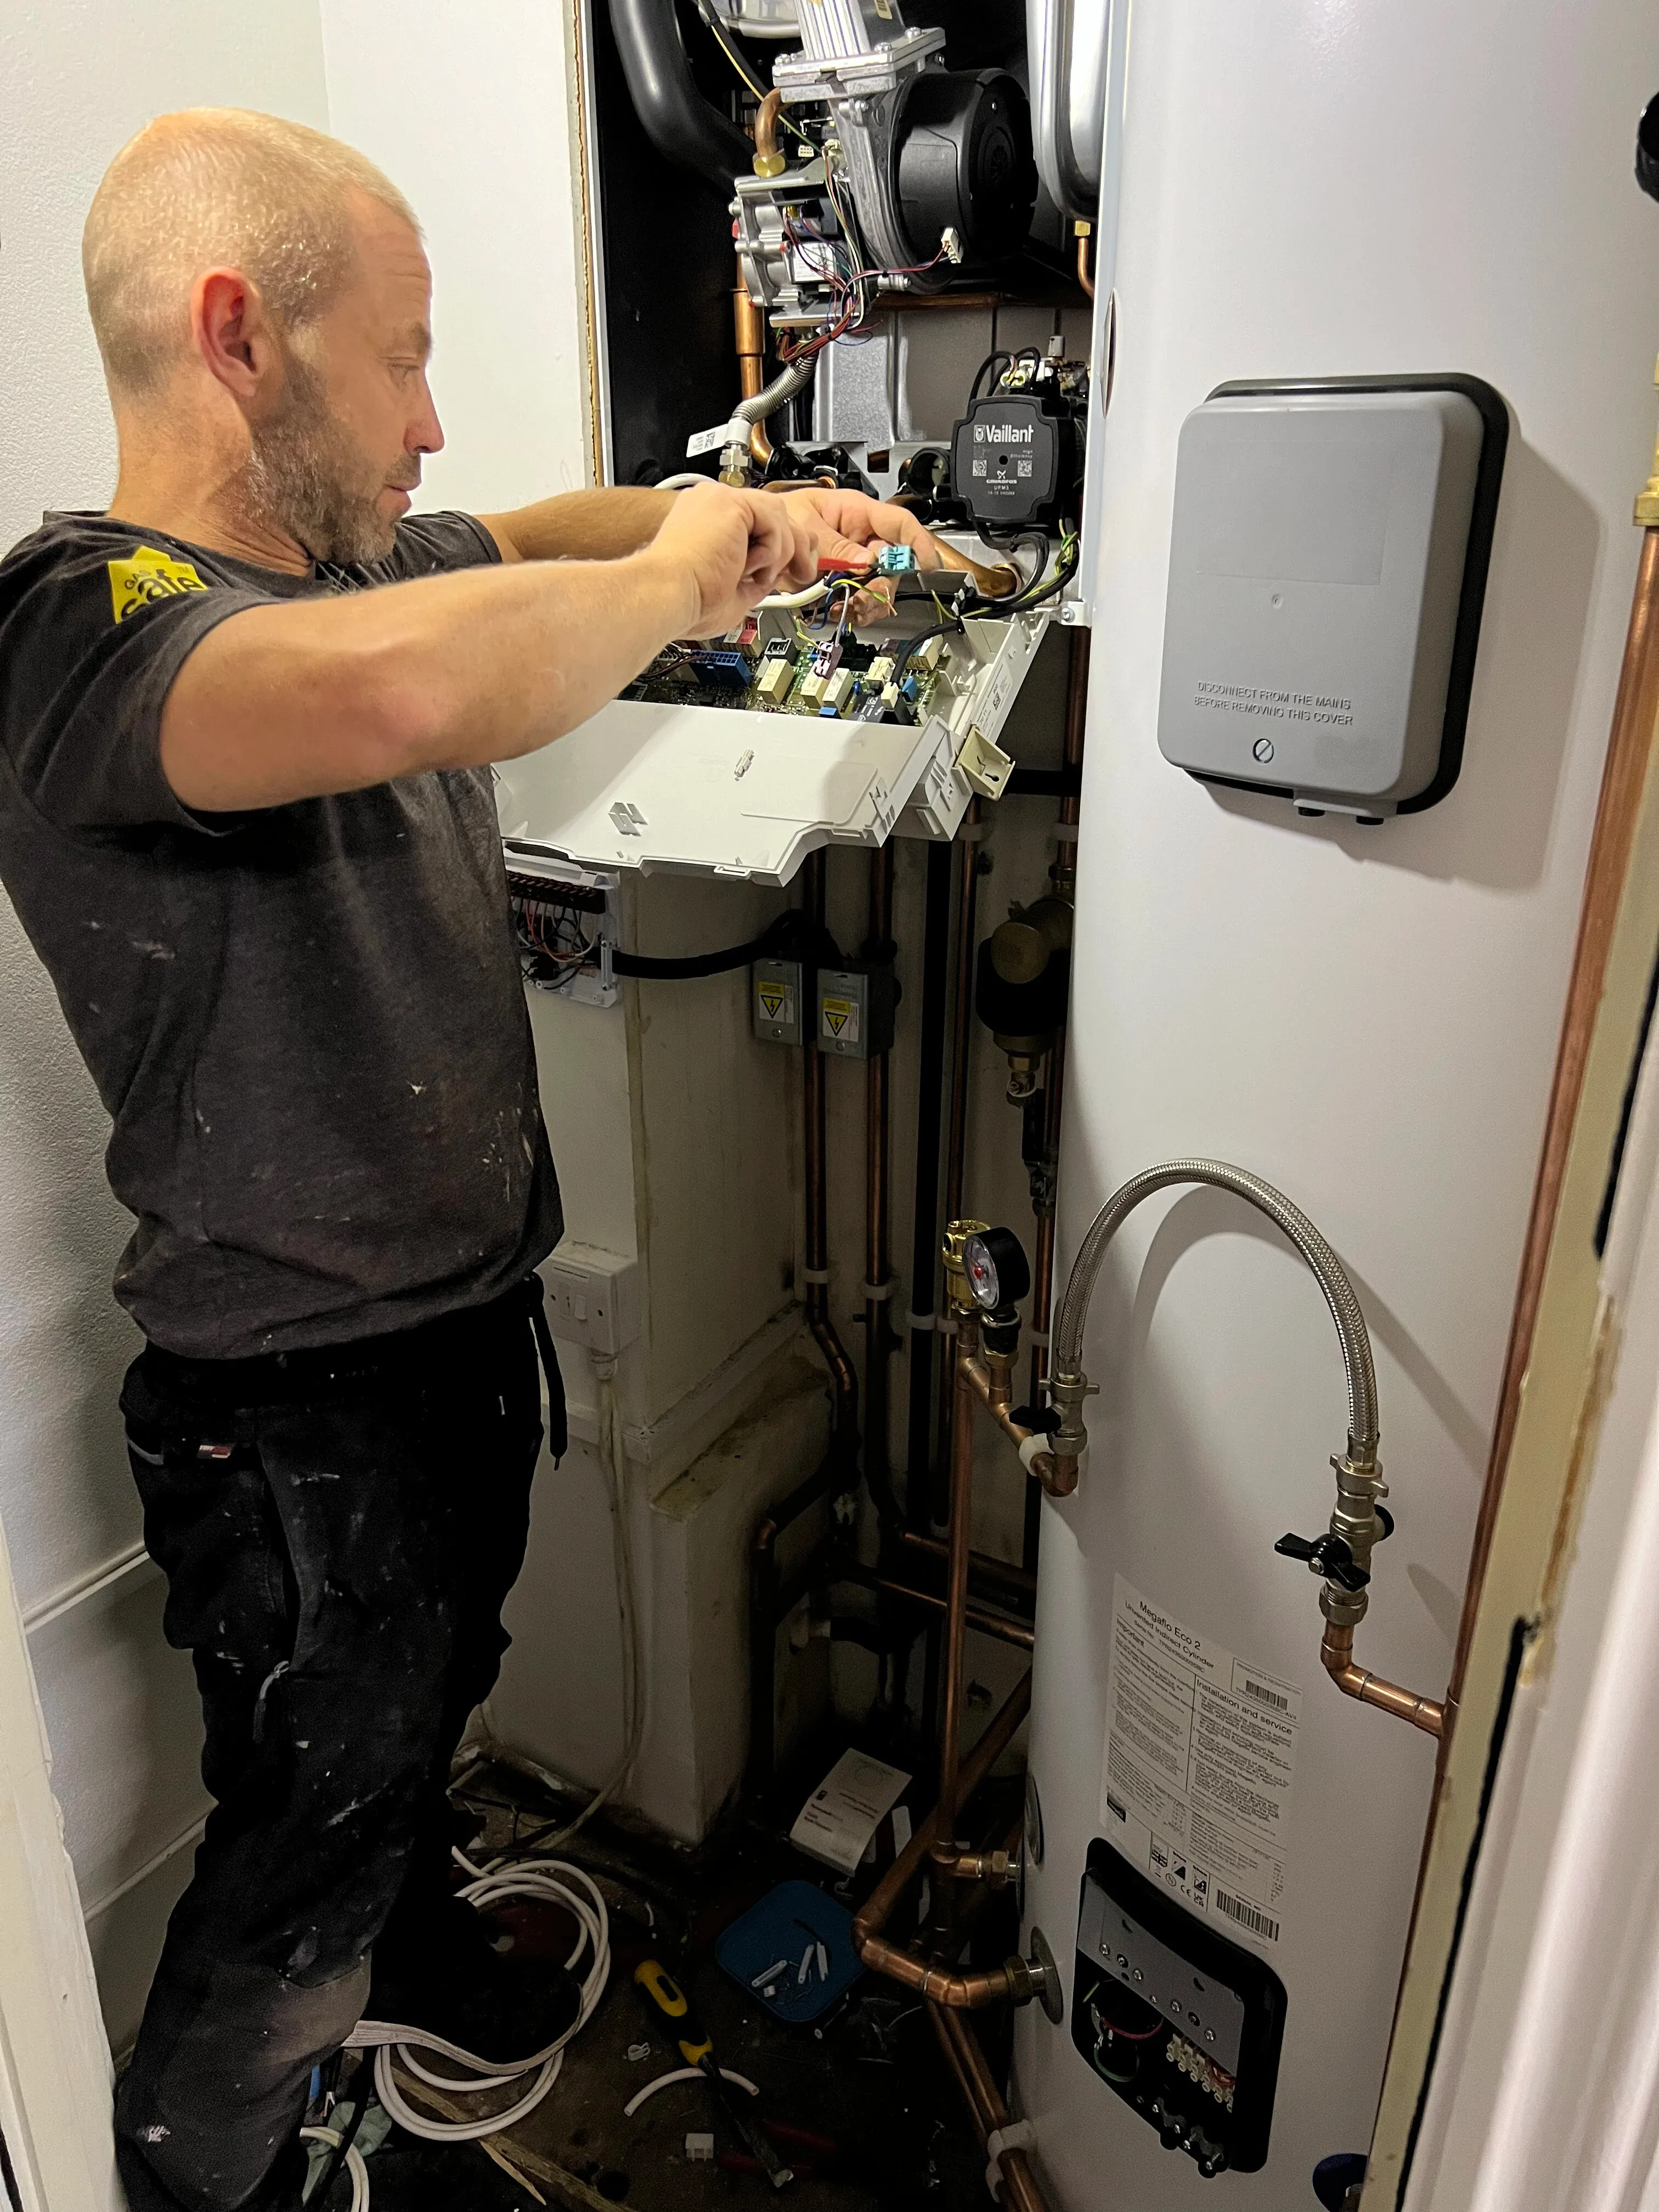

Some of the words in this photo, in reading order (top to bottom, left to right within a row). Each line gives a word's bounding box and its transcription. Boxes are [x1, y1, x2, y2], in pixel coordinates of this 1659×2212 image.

[986, 424, 1034, 443] Vaillant
[1198, 681, 1257, 698] DISCONNECT
[1260, 690, 1289, 703] FROM
[1293, 694, 1313, 706] THE
[1315, 696, 1351, 710] MAINS
[1194, 696, 1230, 710] BEFORE
[1232, 702, 1284, 718] REMOVING
[1288, 709, 1311, 721] THIS
[1313, 712, 1353, 726] COVER
[1116, 1618, 1144, 1648] Important
[1139, 1601, 1172, 1632] Megaflo
[1174, 1627, 1192, 1645] Eco
[1194, 1640, 1201, 1651] 2
[1183, 1645, 1215, 1669] Cylinder
[1197, 1679, 1240, 1712] Installation
[1242, 1706, 1259, 1719] and
[1260, 1716, 1293, 1736] service
